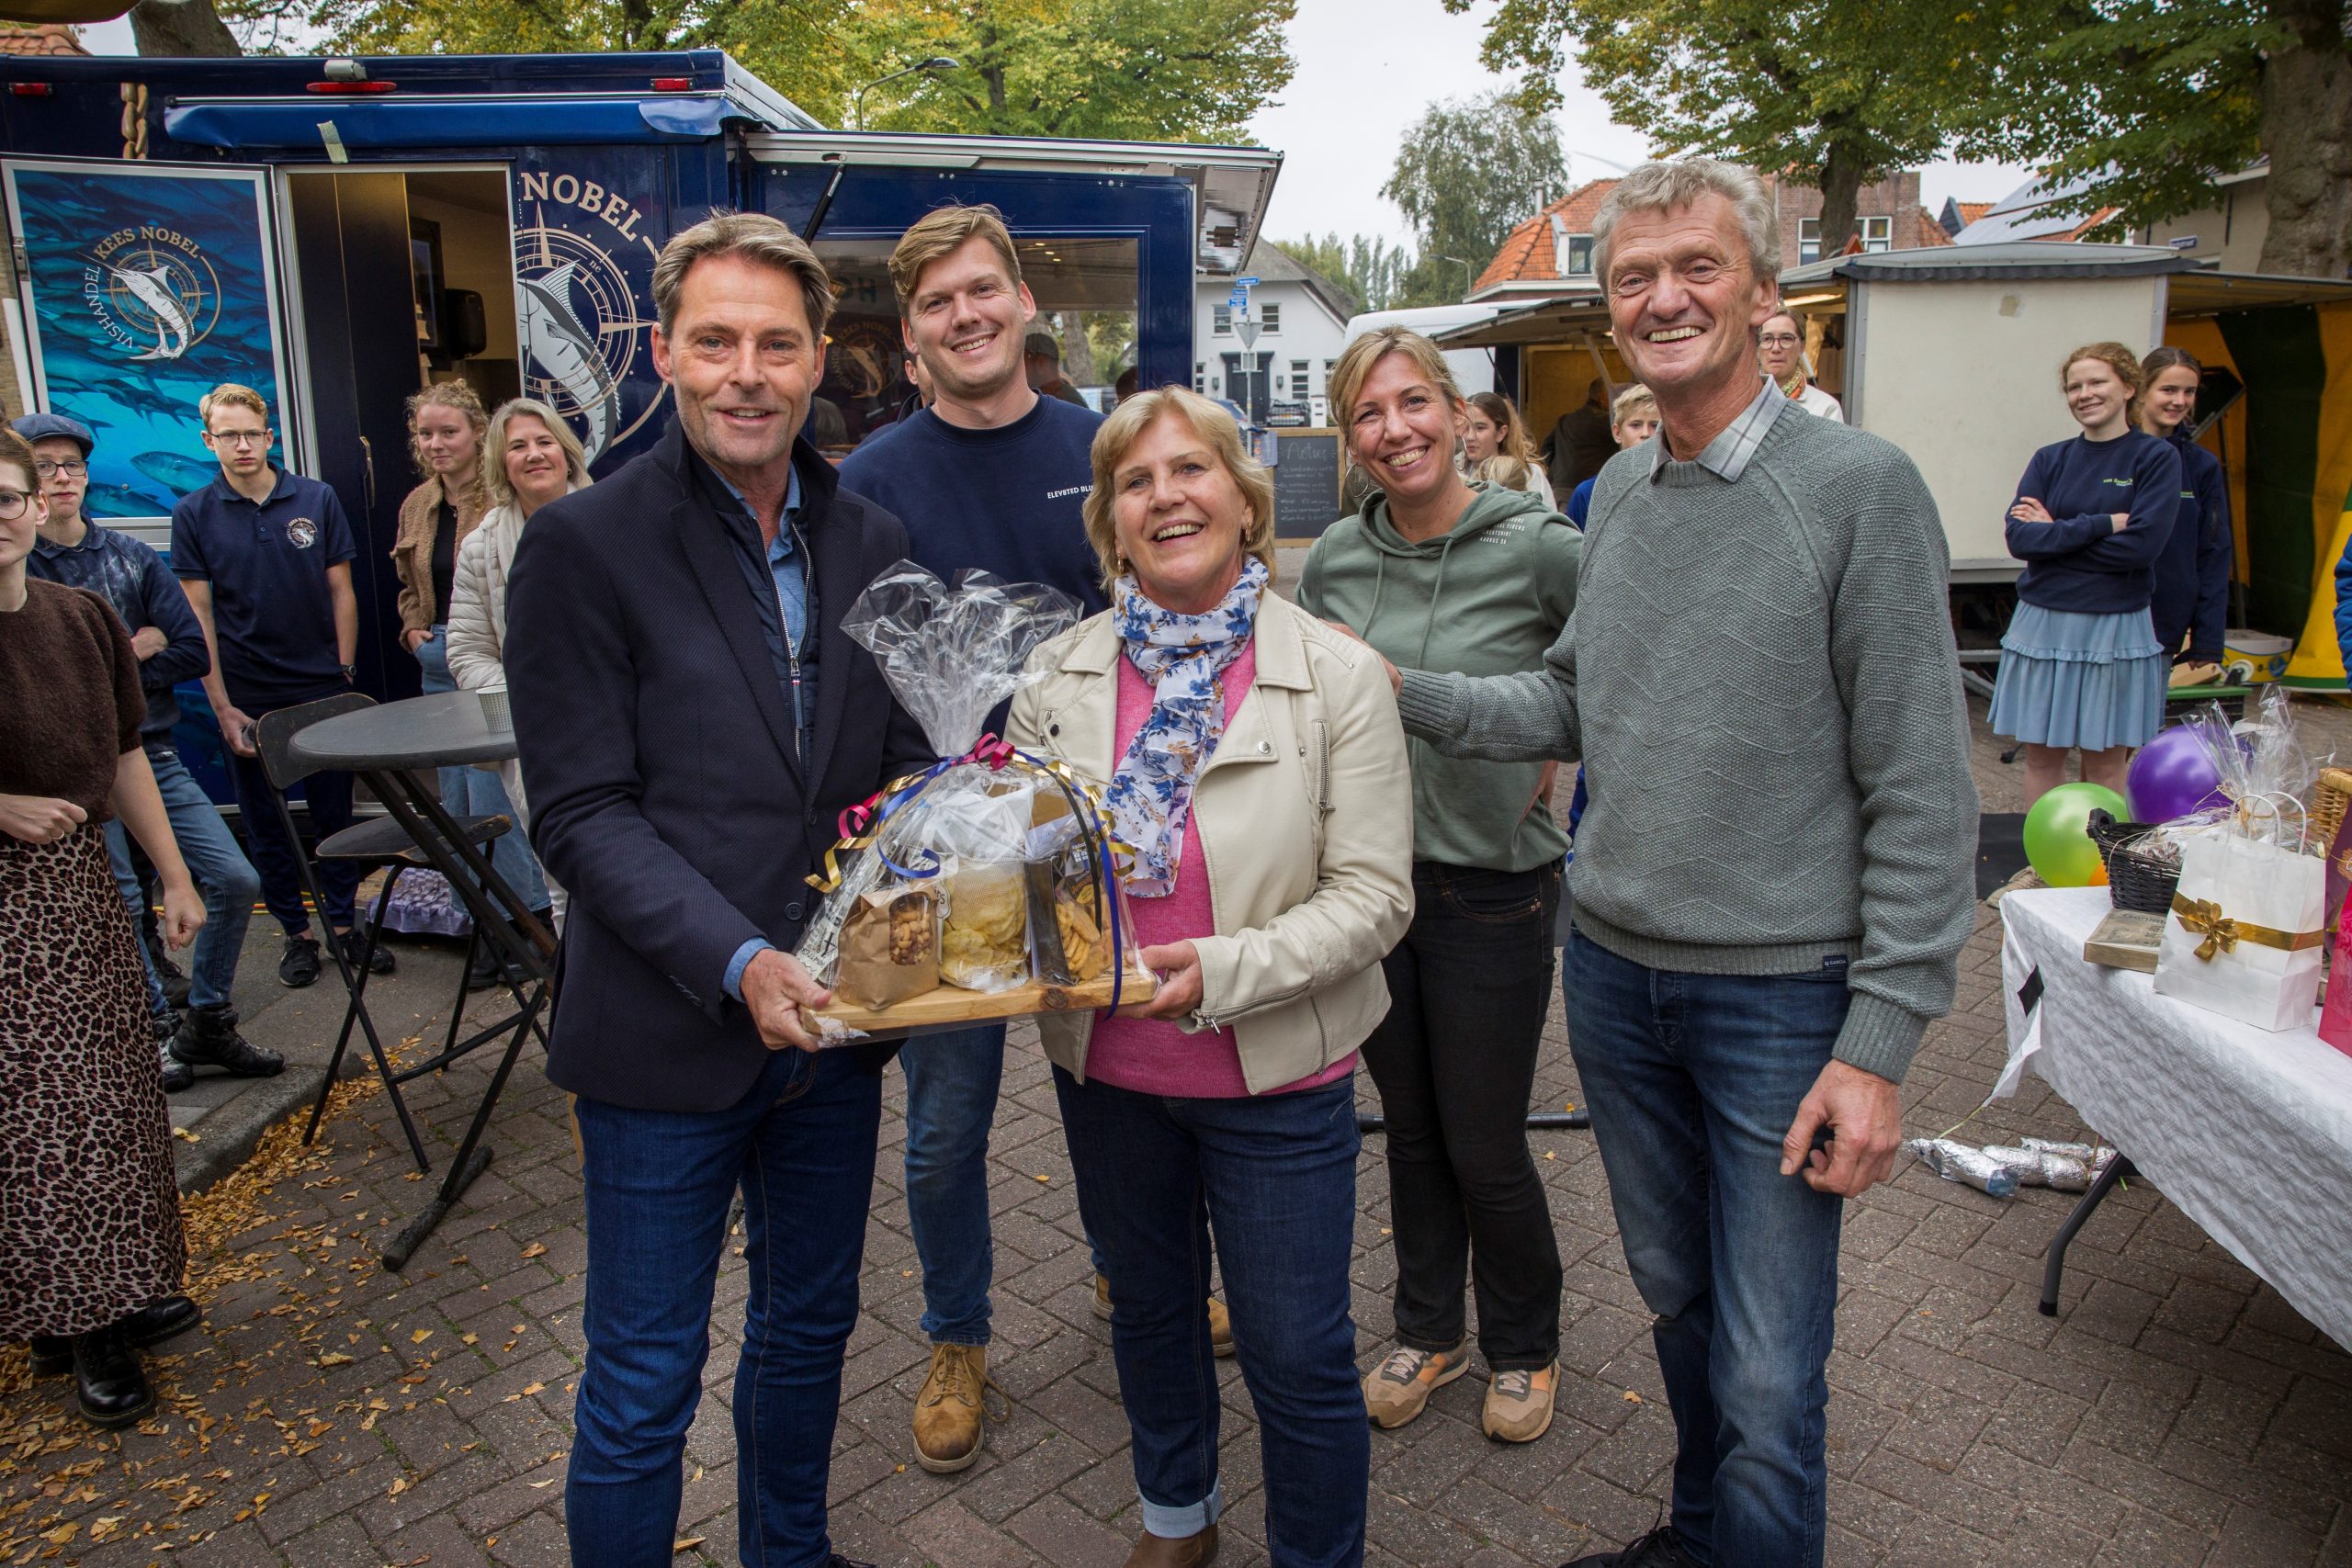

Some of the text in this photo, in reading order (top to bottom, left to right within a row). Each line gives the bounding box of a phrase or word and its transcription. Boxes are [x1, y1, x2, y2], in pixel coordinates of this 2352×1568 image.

[520, 171, 642, 243] NOBEL
[93, 226, 201, 260] KEES NOBEL
[589, 259, 602, 273] ne
[85, 265, 133, 349] VISHANDEL
[1047, 487, 1079, 499] ELEV8TED
